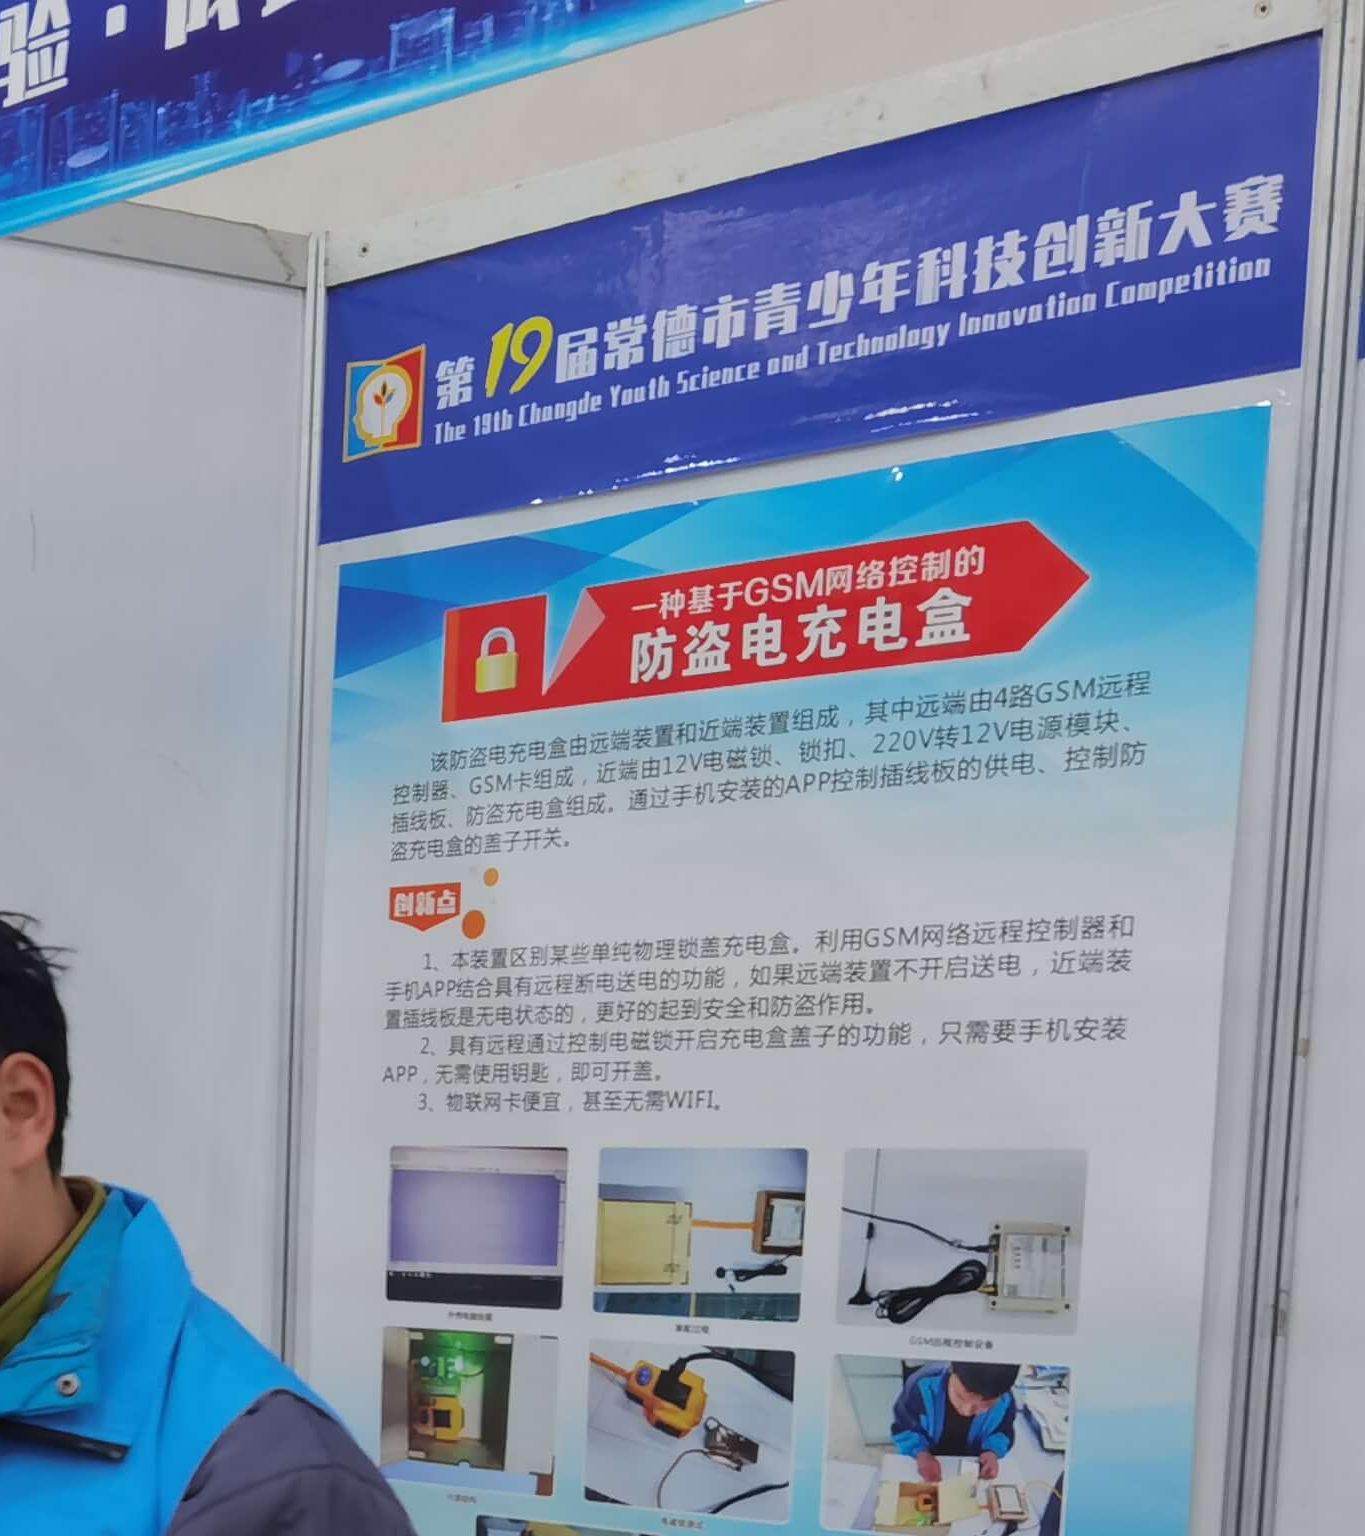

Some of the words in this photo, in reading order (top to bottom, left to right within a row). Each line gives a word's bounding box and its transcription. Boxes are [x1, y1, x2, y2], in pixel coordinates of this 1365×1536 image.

[436, 173, 1285, 410] 第19届常德市青少年科技创新大赛
[434, 420, 467, 446] The
[473, 408, 513, 437] 19th
[518, 390, 603, 429] Changde
[609, 376, 670, 409] Youth
[676, 359, 760, 395] Science
[767, 347, 809, 376] and
[816, 321, 951, 366] Technology
[958, 292, 1098, 339] Innovation
[1104, 256, 1272, 309] Competition
[630, 544, 987, 618] 一种基于GSM网络控制的
[629, 587, 973, 686] 防盗电充电盒
[390, 826, 570, 863] 盗充电盒的盖子开关。
[394, 890, 457, 918] 创新点
